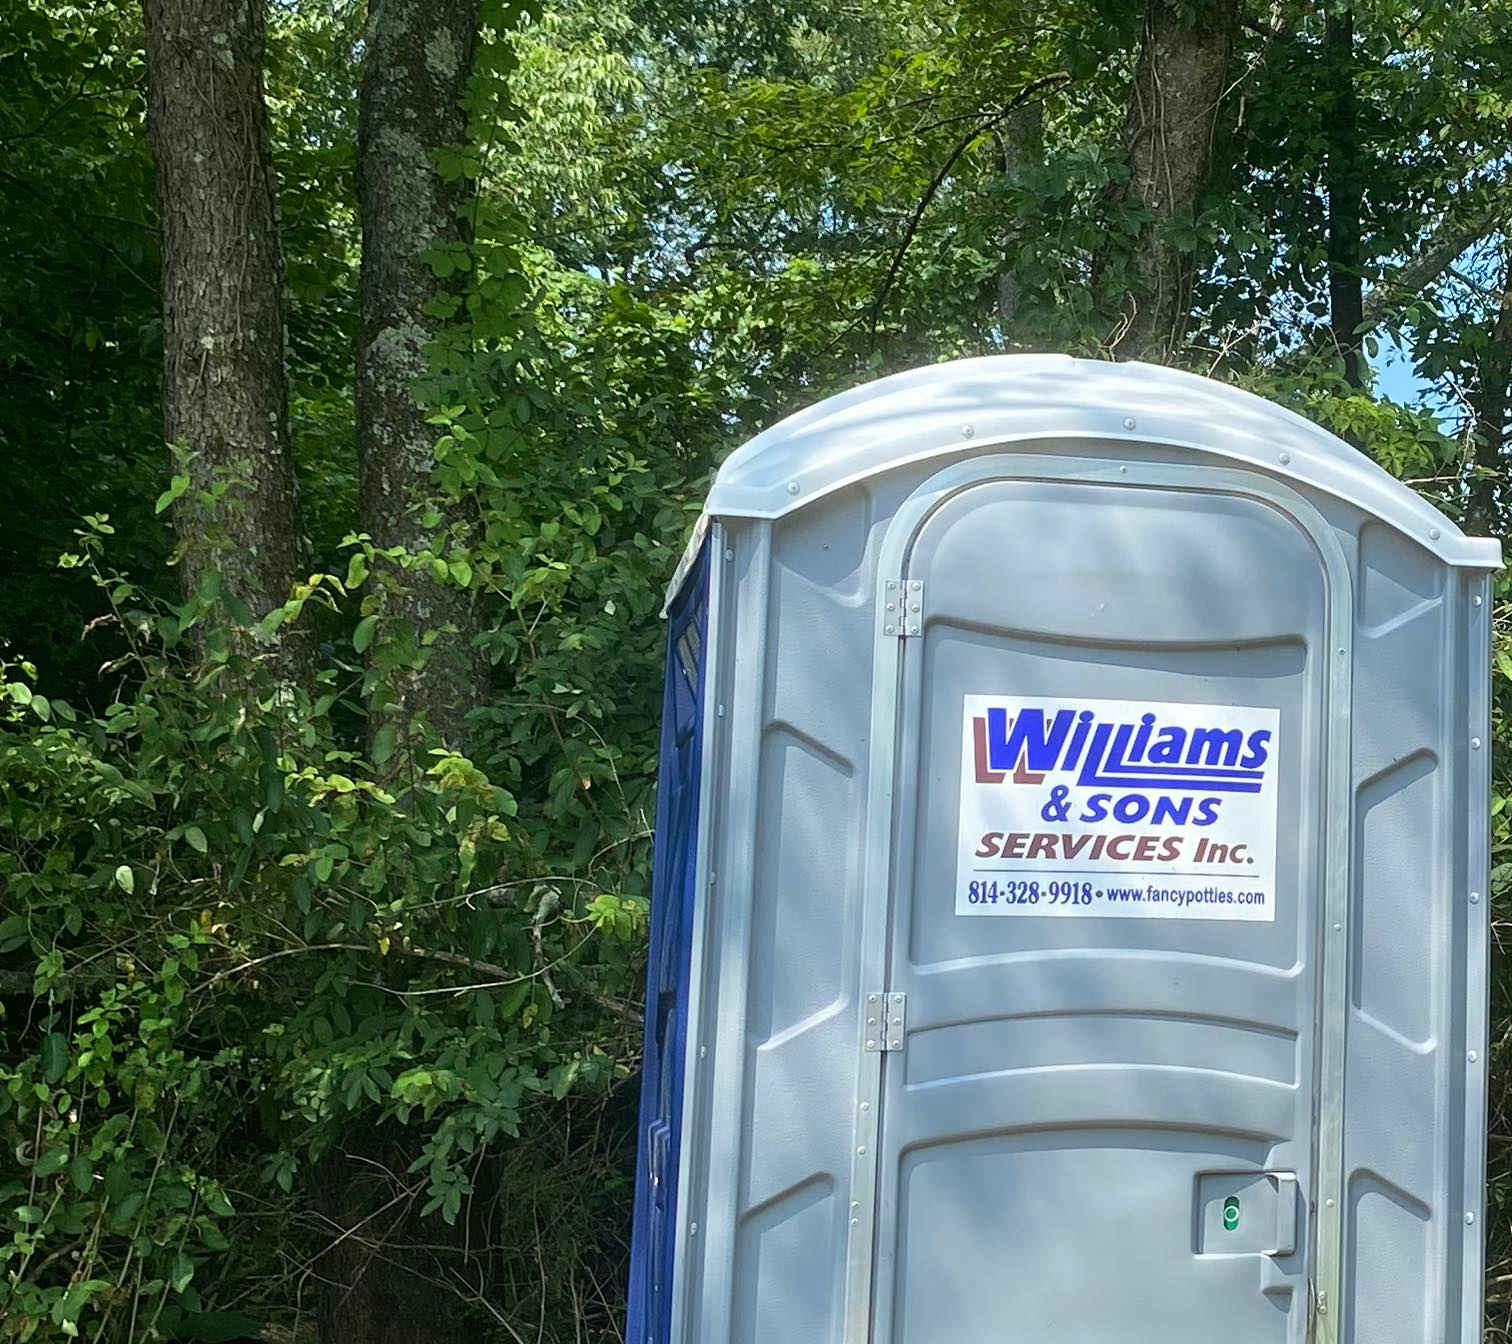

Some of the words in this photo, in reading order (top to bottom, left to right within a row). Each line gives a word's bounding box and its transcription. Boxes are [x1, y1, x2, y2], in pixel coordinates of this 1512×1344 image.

[1041, 784, 1072, 822] &
[1079, 793, 1222, 826] SONS
[975, 832, 1183, 861] SERVICES
[1193, 838, 1254, 864] Inc.
[968, 880, 1092, 905] 814-328-9918
[1107, 885, 1265, 906] www.fancypotties.com
